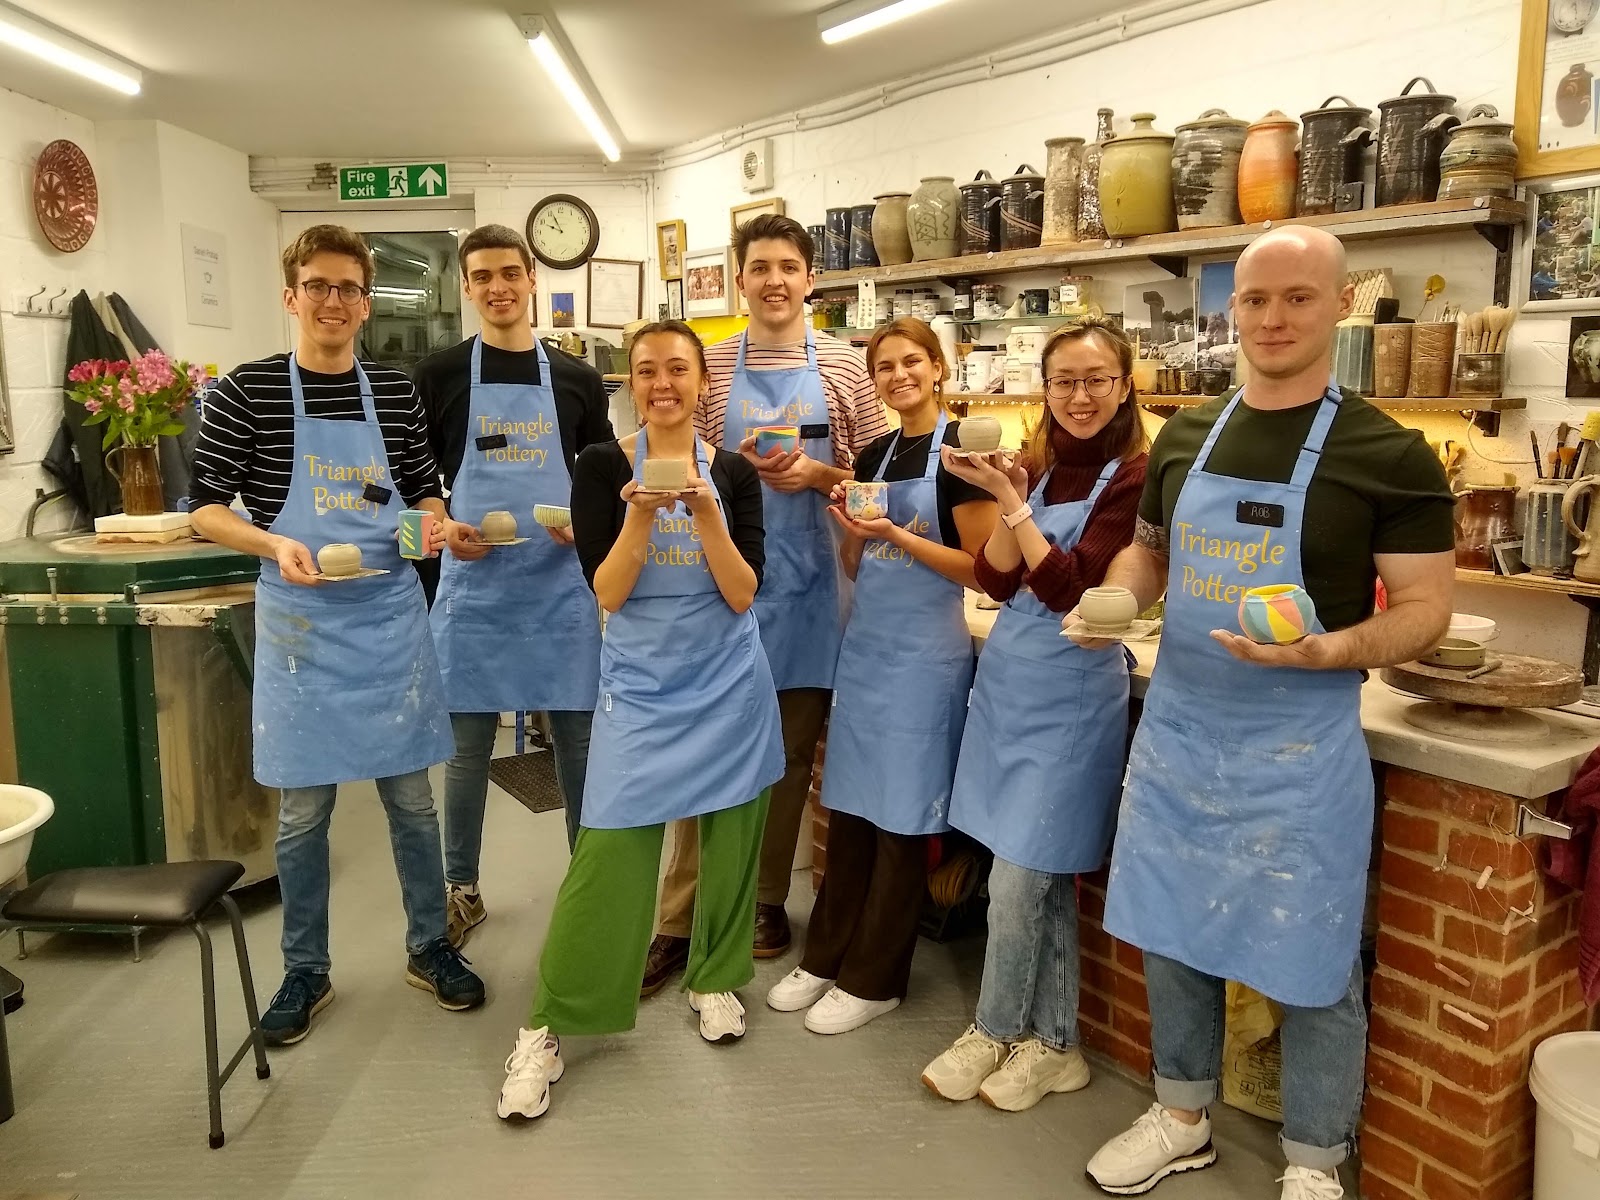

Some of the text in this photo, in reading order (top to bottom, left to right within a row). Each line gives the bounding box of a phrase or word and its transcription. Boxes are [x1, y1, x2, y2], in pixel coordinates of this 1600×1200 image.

[347, 170, 376, 183] Fire
[348, 184, 376, 198] exit
[476, 412, 553, 442] Triangle
[303, 455, 386, 489] Triangle
[1251, 505, 1271, 519] ROB
[643, 542, 710, 573] Potter
[1177, 522, 1286, 574] Triangle
[1182, 564, 1253, 604] Potter
